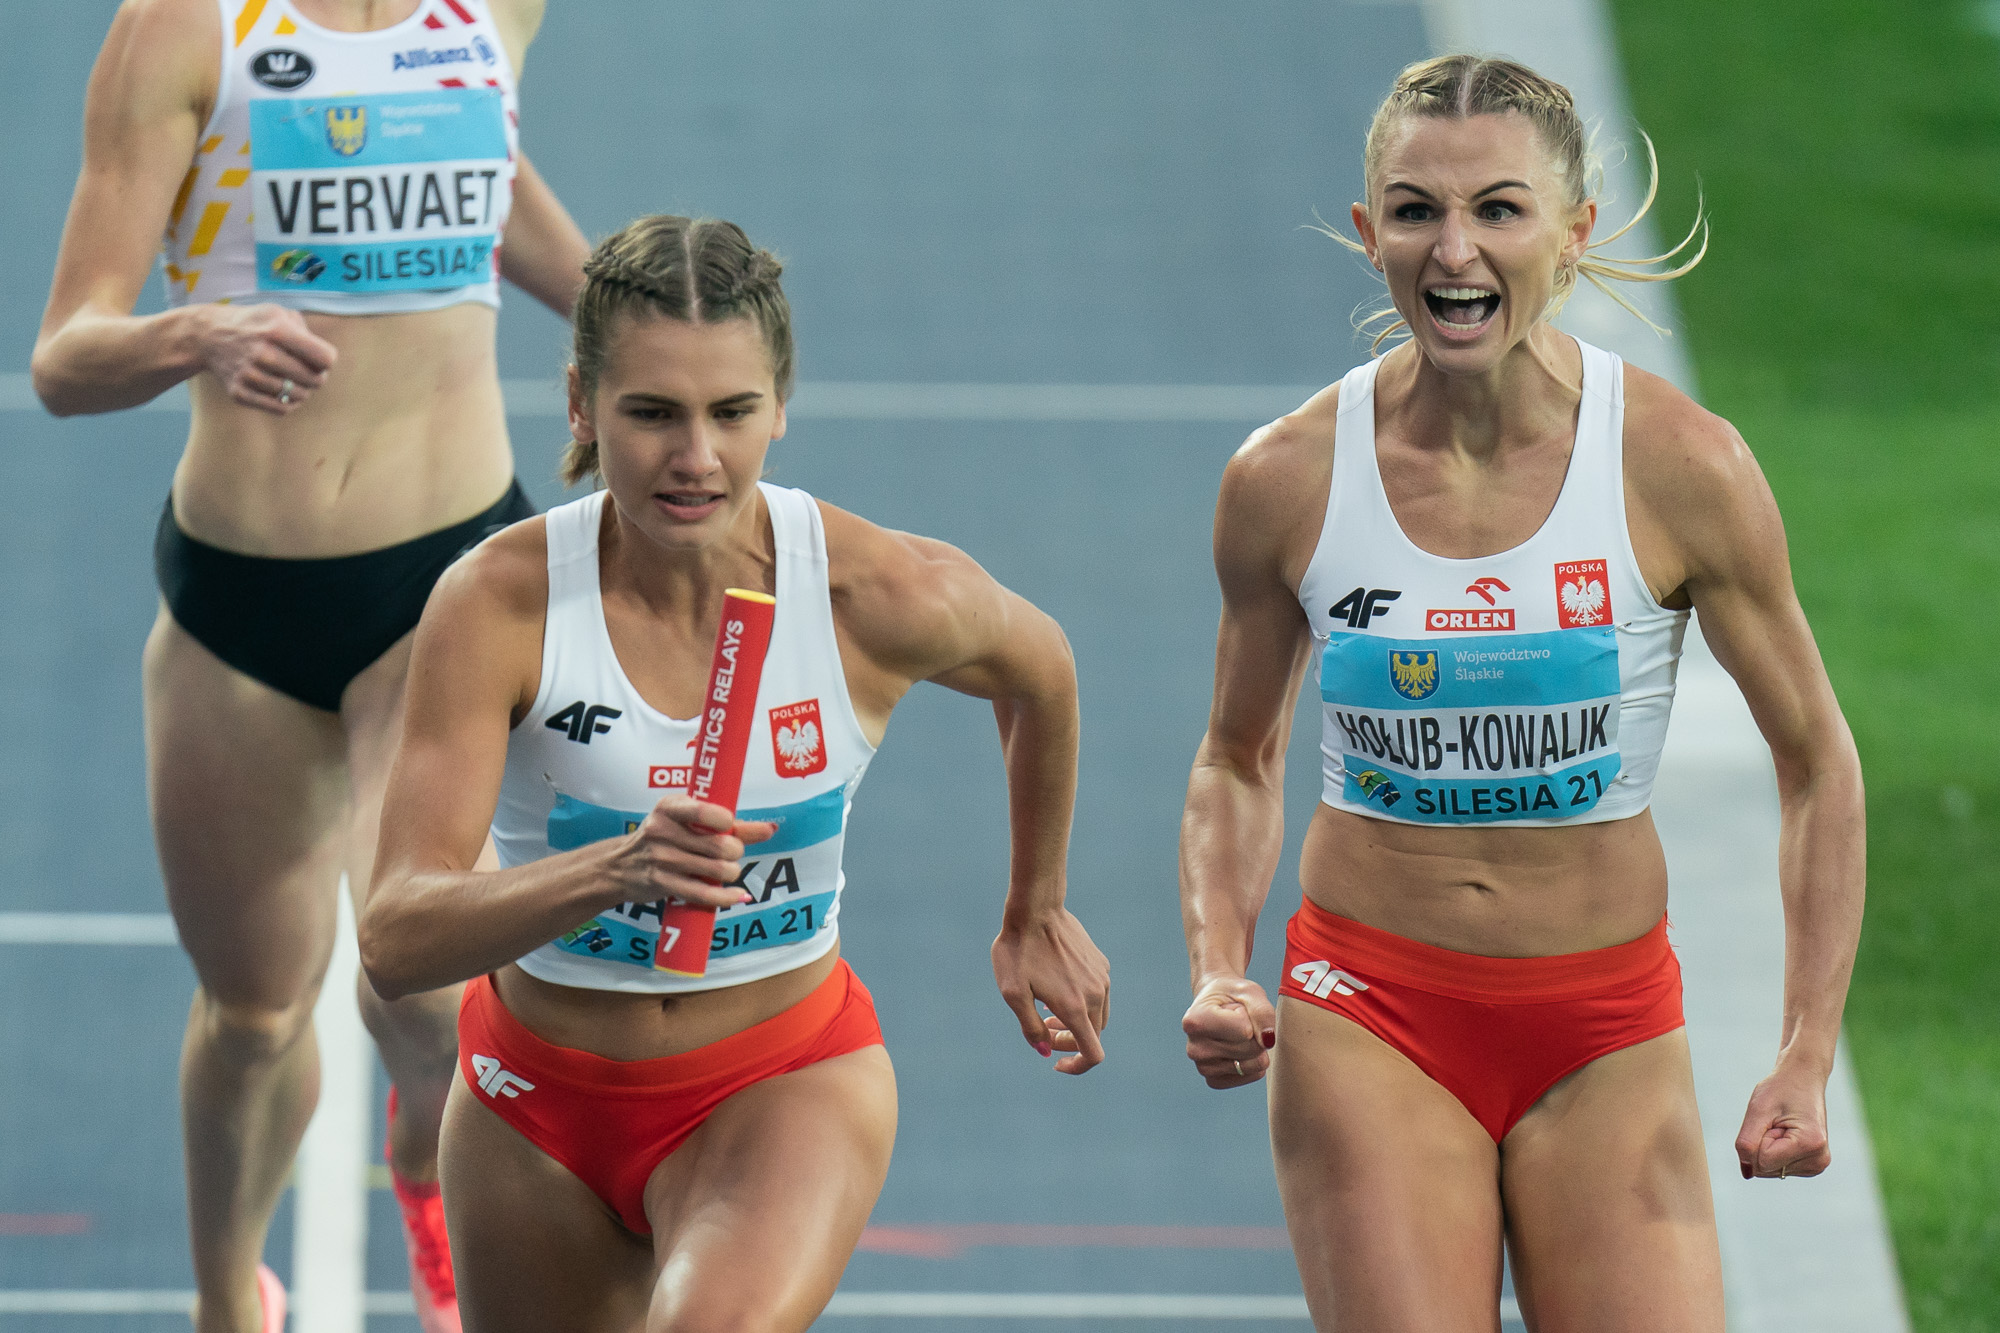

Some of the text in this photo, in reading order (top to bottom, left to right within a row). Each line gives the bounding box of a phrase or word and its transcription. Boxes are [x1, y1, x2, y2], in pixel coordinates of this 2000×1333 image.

[268, 170, 498, 234] VERVAET
[341, 246, 467, 281] SILESIA
[1558, 562, 1604, 575] POLSKA
[1329, 587, 1402, 629] 4F
[1430, 612, 1510, 628] ORLEN
[1453, 648, 1550, 665] Województwo
[1455, 667, 1505, 683] Śląskie
[545, 700, 622, 745] 4F
[691, 619, 745, 799] HLETICS RELAYS
[772, 702, 816, 720] POLSKA
[1336, 704, 1610, 771] HOŁUB-KOWALIK
[1415, 769, 1602, 816] SILESIA 21
[628, 904, 813, 961] SSIA 21
[663, 926, 681, 953] 7
[1291, 960, 1369, 1000] 4F
[472, 1053, 535, 1099] 4F
